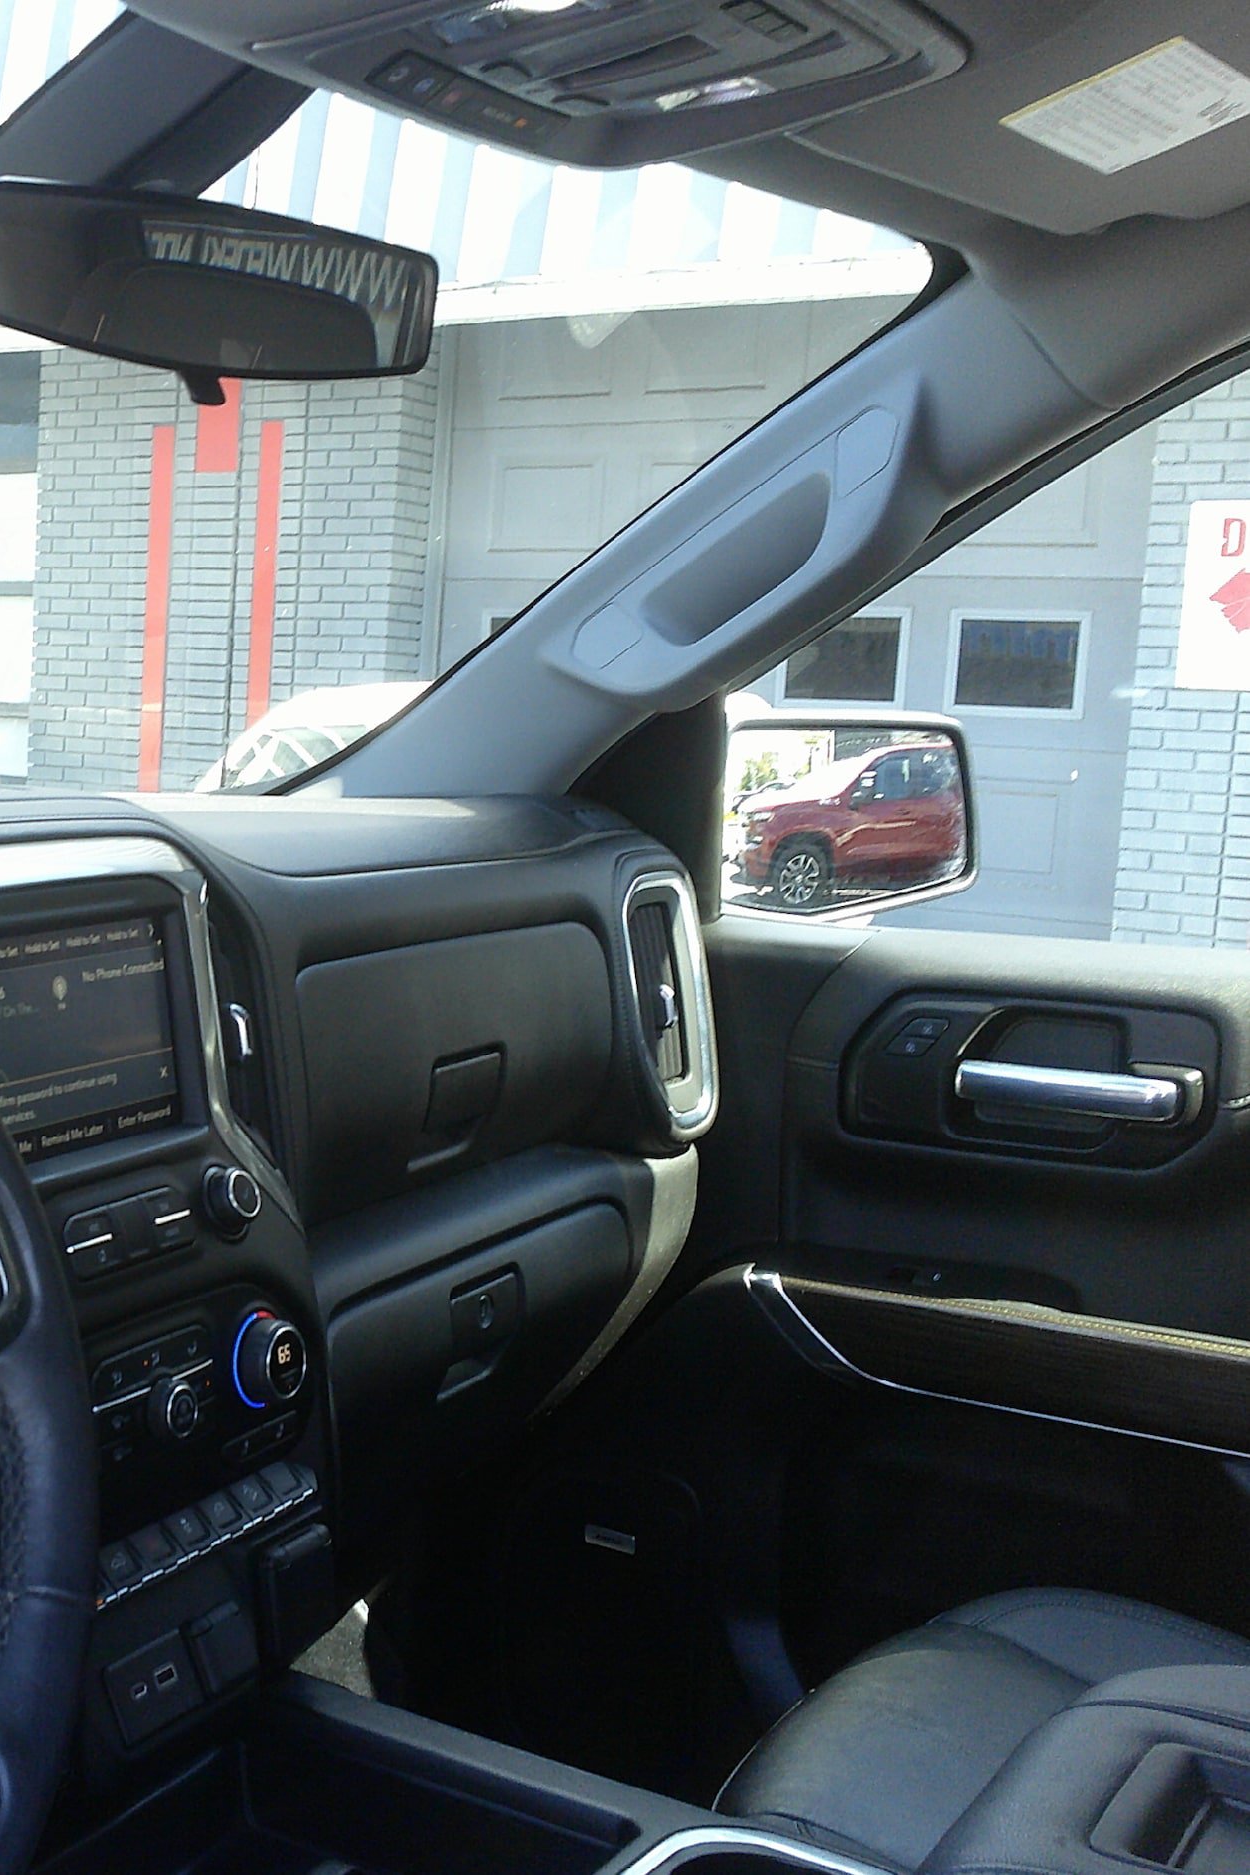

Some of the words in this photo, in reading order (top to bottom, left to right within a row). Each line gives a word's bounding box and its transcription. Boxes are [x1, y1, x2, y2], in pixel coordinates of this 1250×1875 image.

[117, 1115, 138, 1130] Enter
[40, 1131, 71, 1148] Remind
[83, 1123, 104, 1137] Later
[277, 1343, 292, 1365] 65
